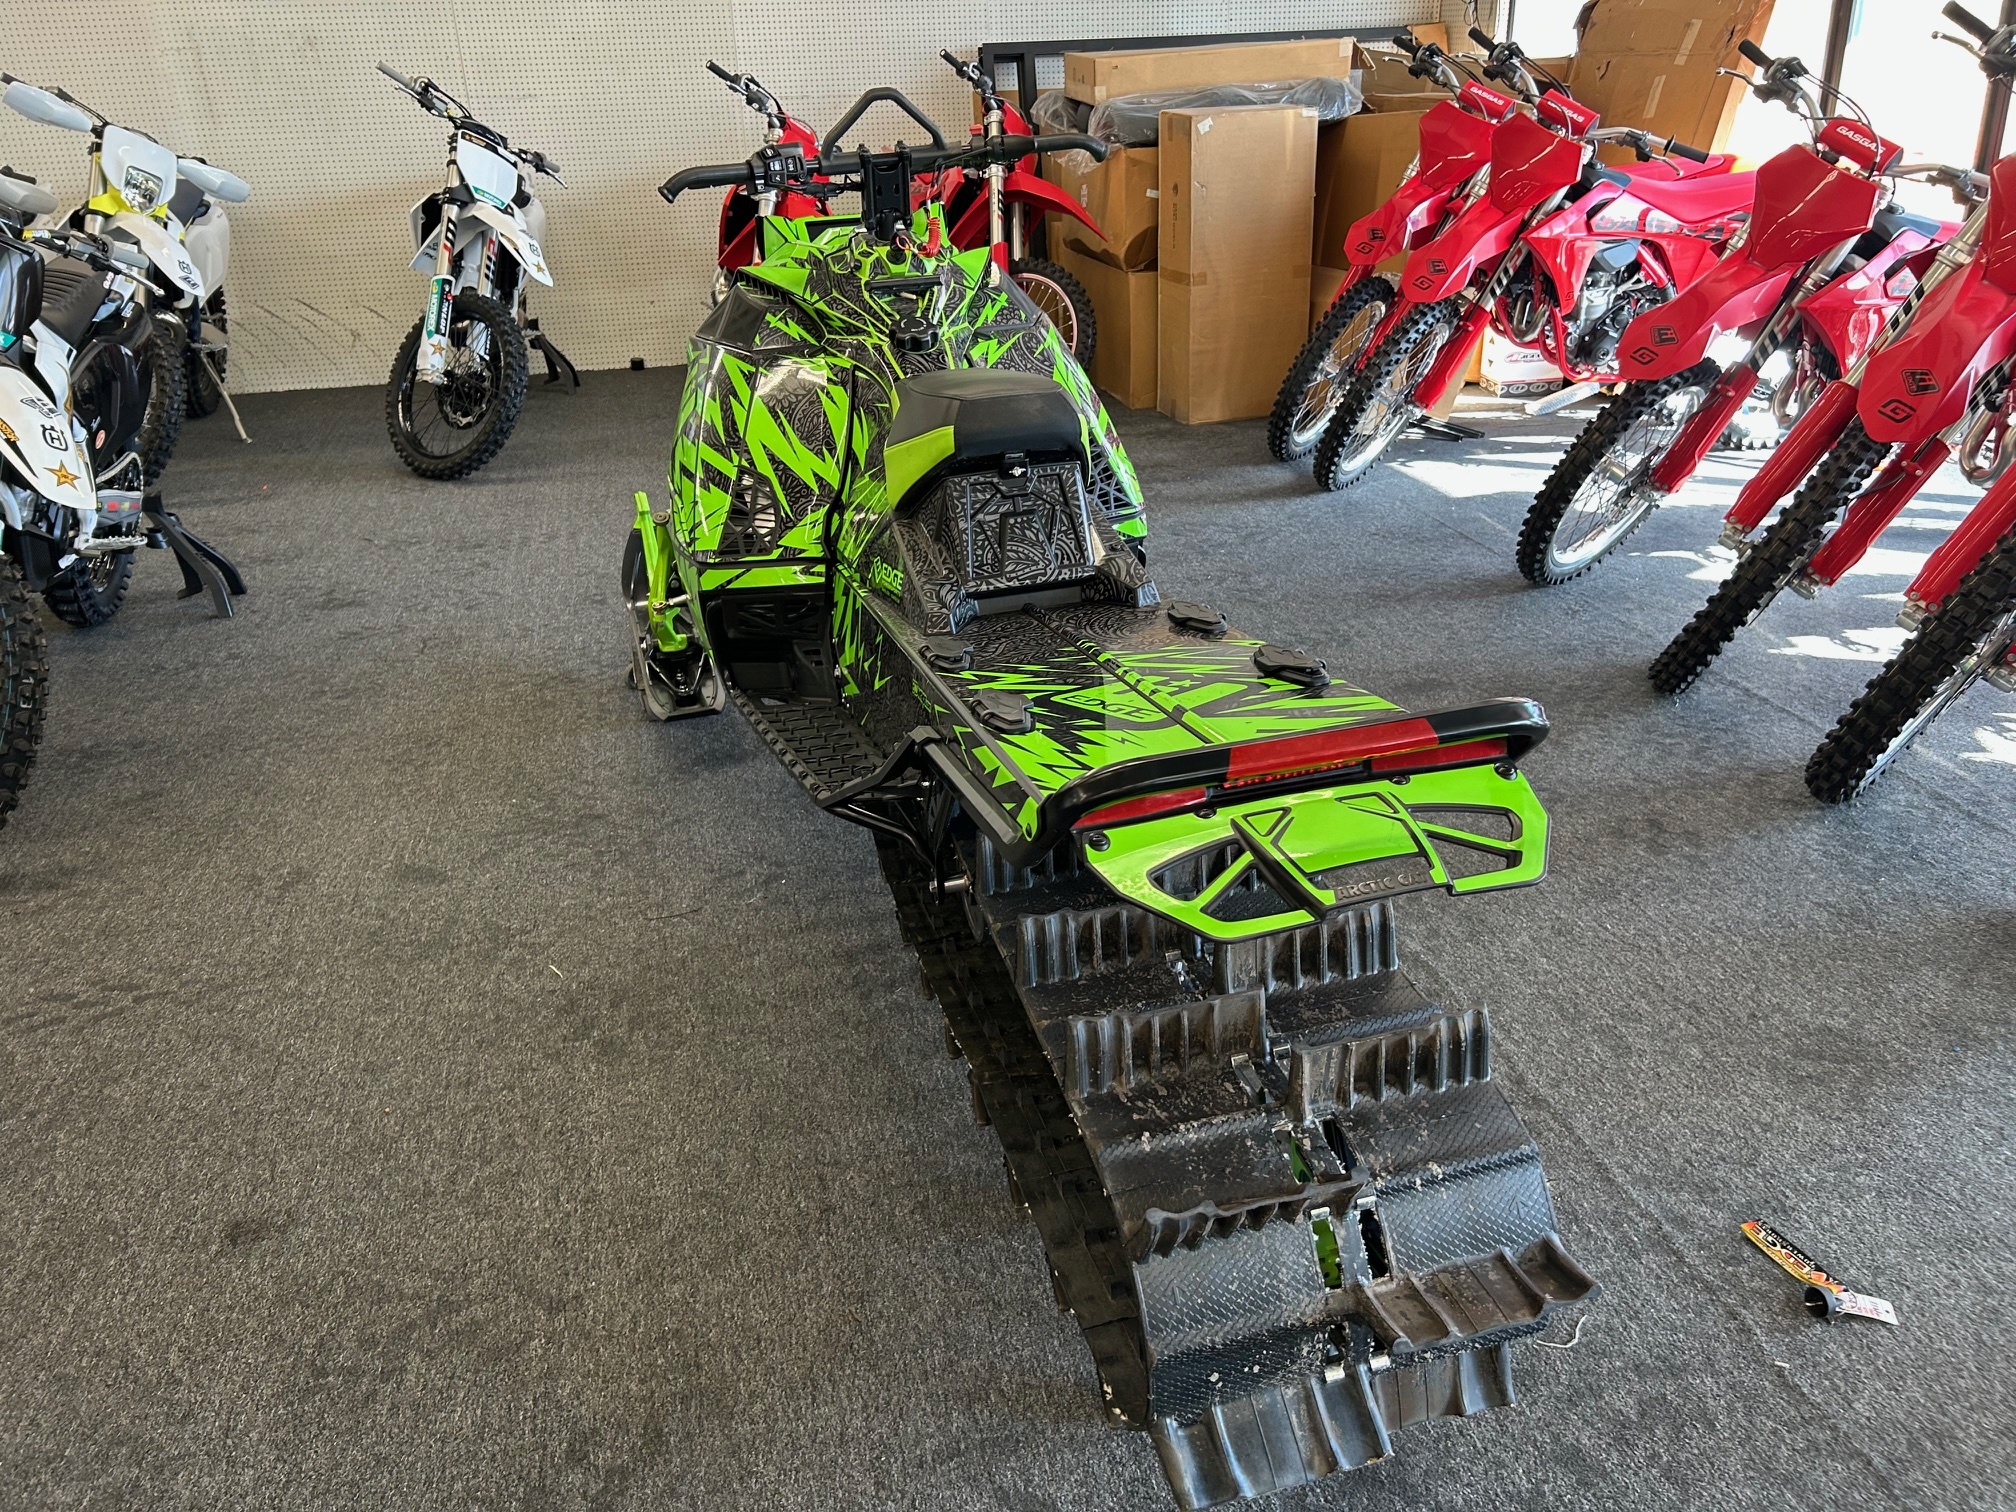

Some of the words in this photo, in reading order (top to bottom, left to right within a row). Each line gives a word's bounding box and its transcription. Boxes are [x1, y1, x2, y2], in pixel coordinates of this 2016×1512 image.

[1470, 86, 1505, 106] GASGAS
[427, 294, 438, 331] MOTOREX
[882, 562, 904, 591] EDGE
[1061, 694, 1161, 719] EDGE
[1336, 876, 1395, 900] ARCTIC
[1748, 1223, 1812, 1274] EDGE
